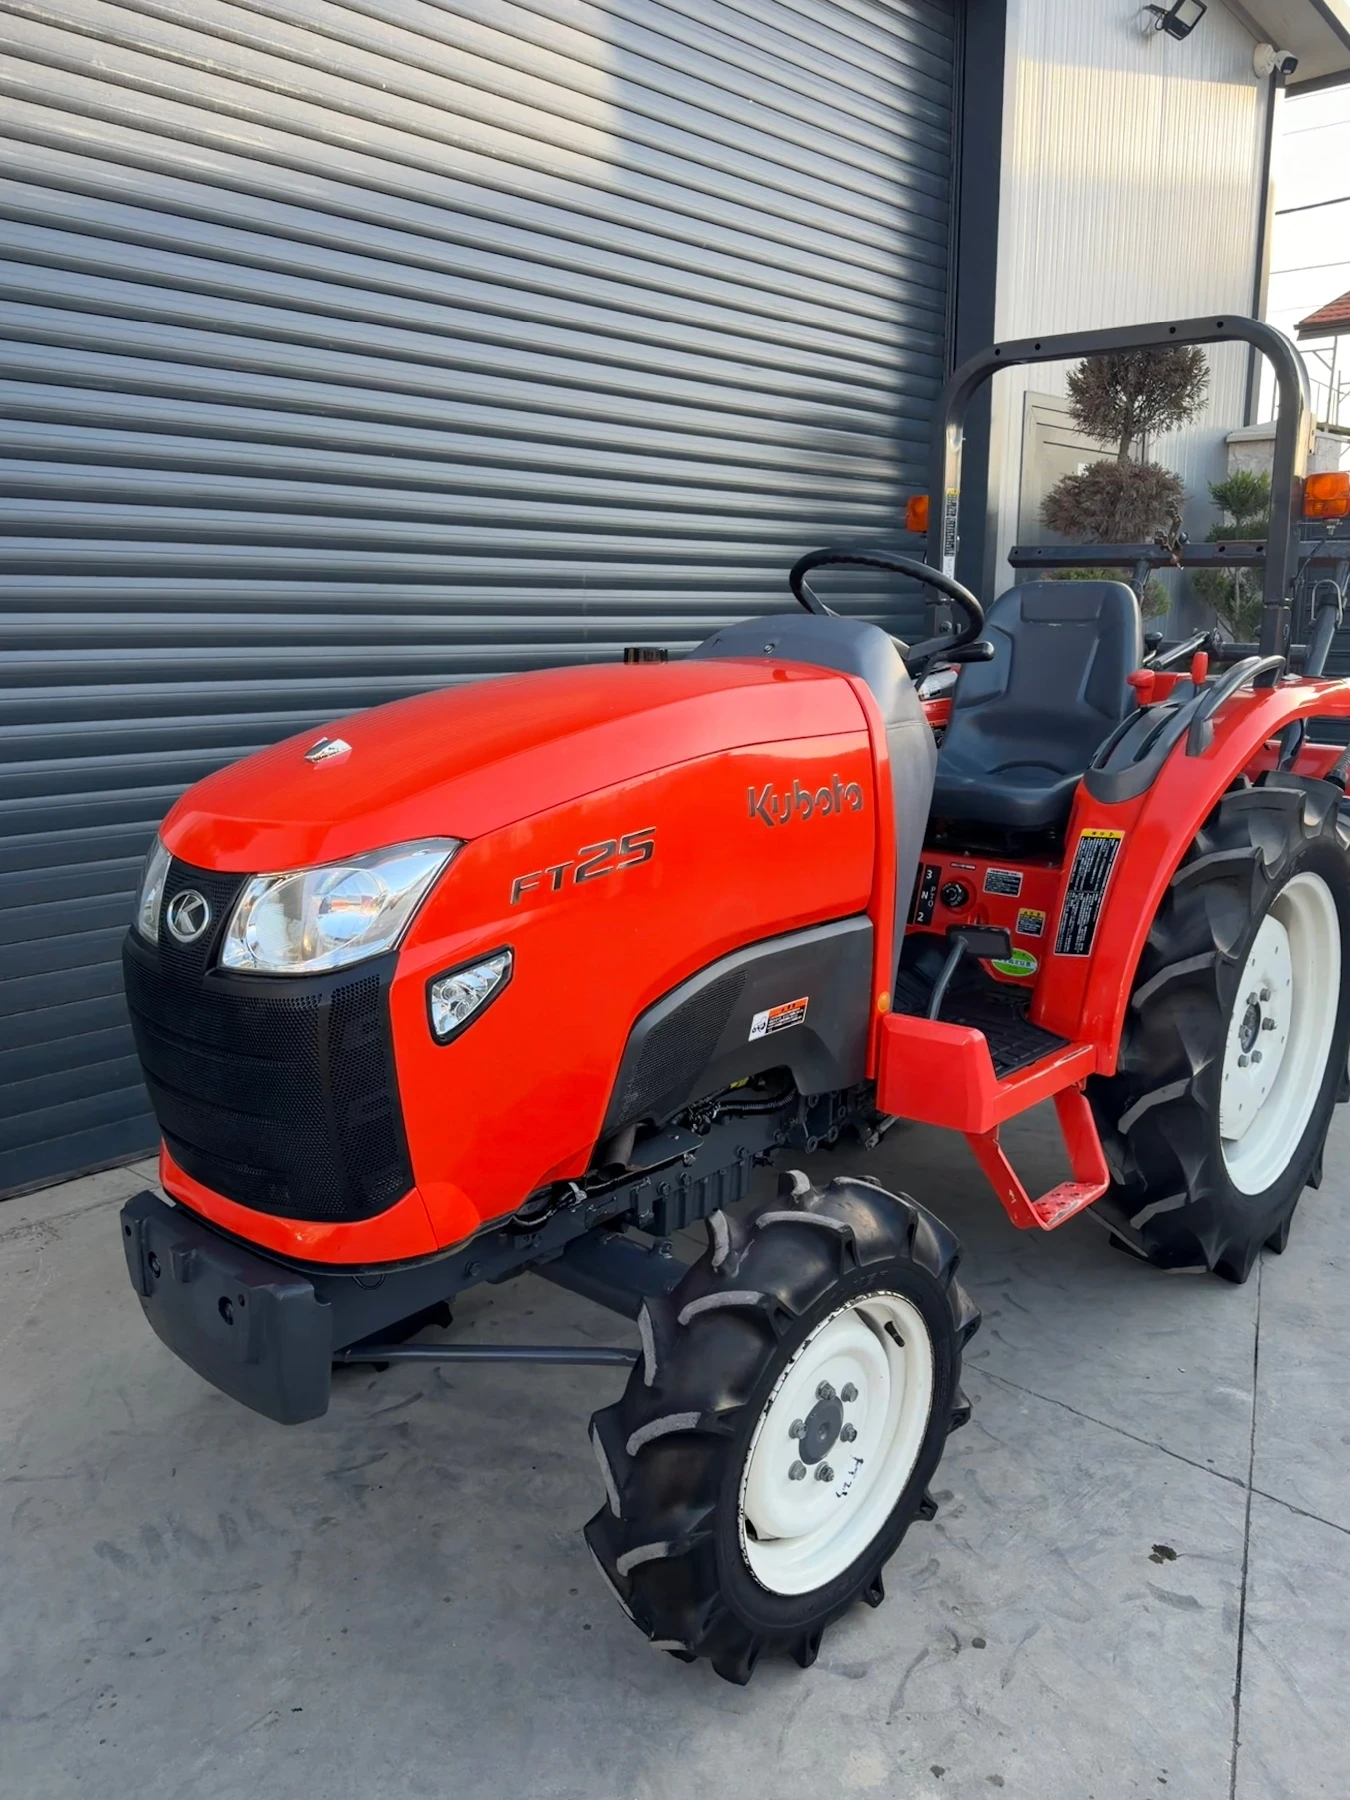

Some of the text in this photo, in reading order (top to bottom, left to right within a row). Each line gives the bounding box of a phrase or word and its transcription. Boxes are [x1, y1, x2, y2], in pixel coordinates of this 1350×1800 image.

[748, 773, 864, 828] Kubota
[510, 826, 657, 905] FT25
[926, 869, 933, 879] 3
[921, 891, 929, 899] N
[917, 911, 924, 922] 2
